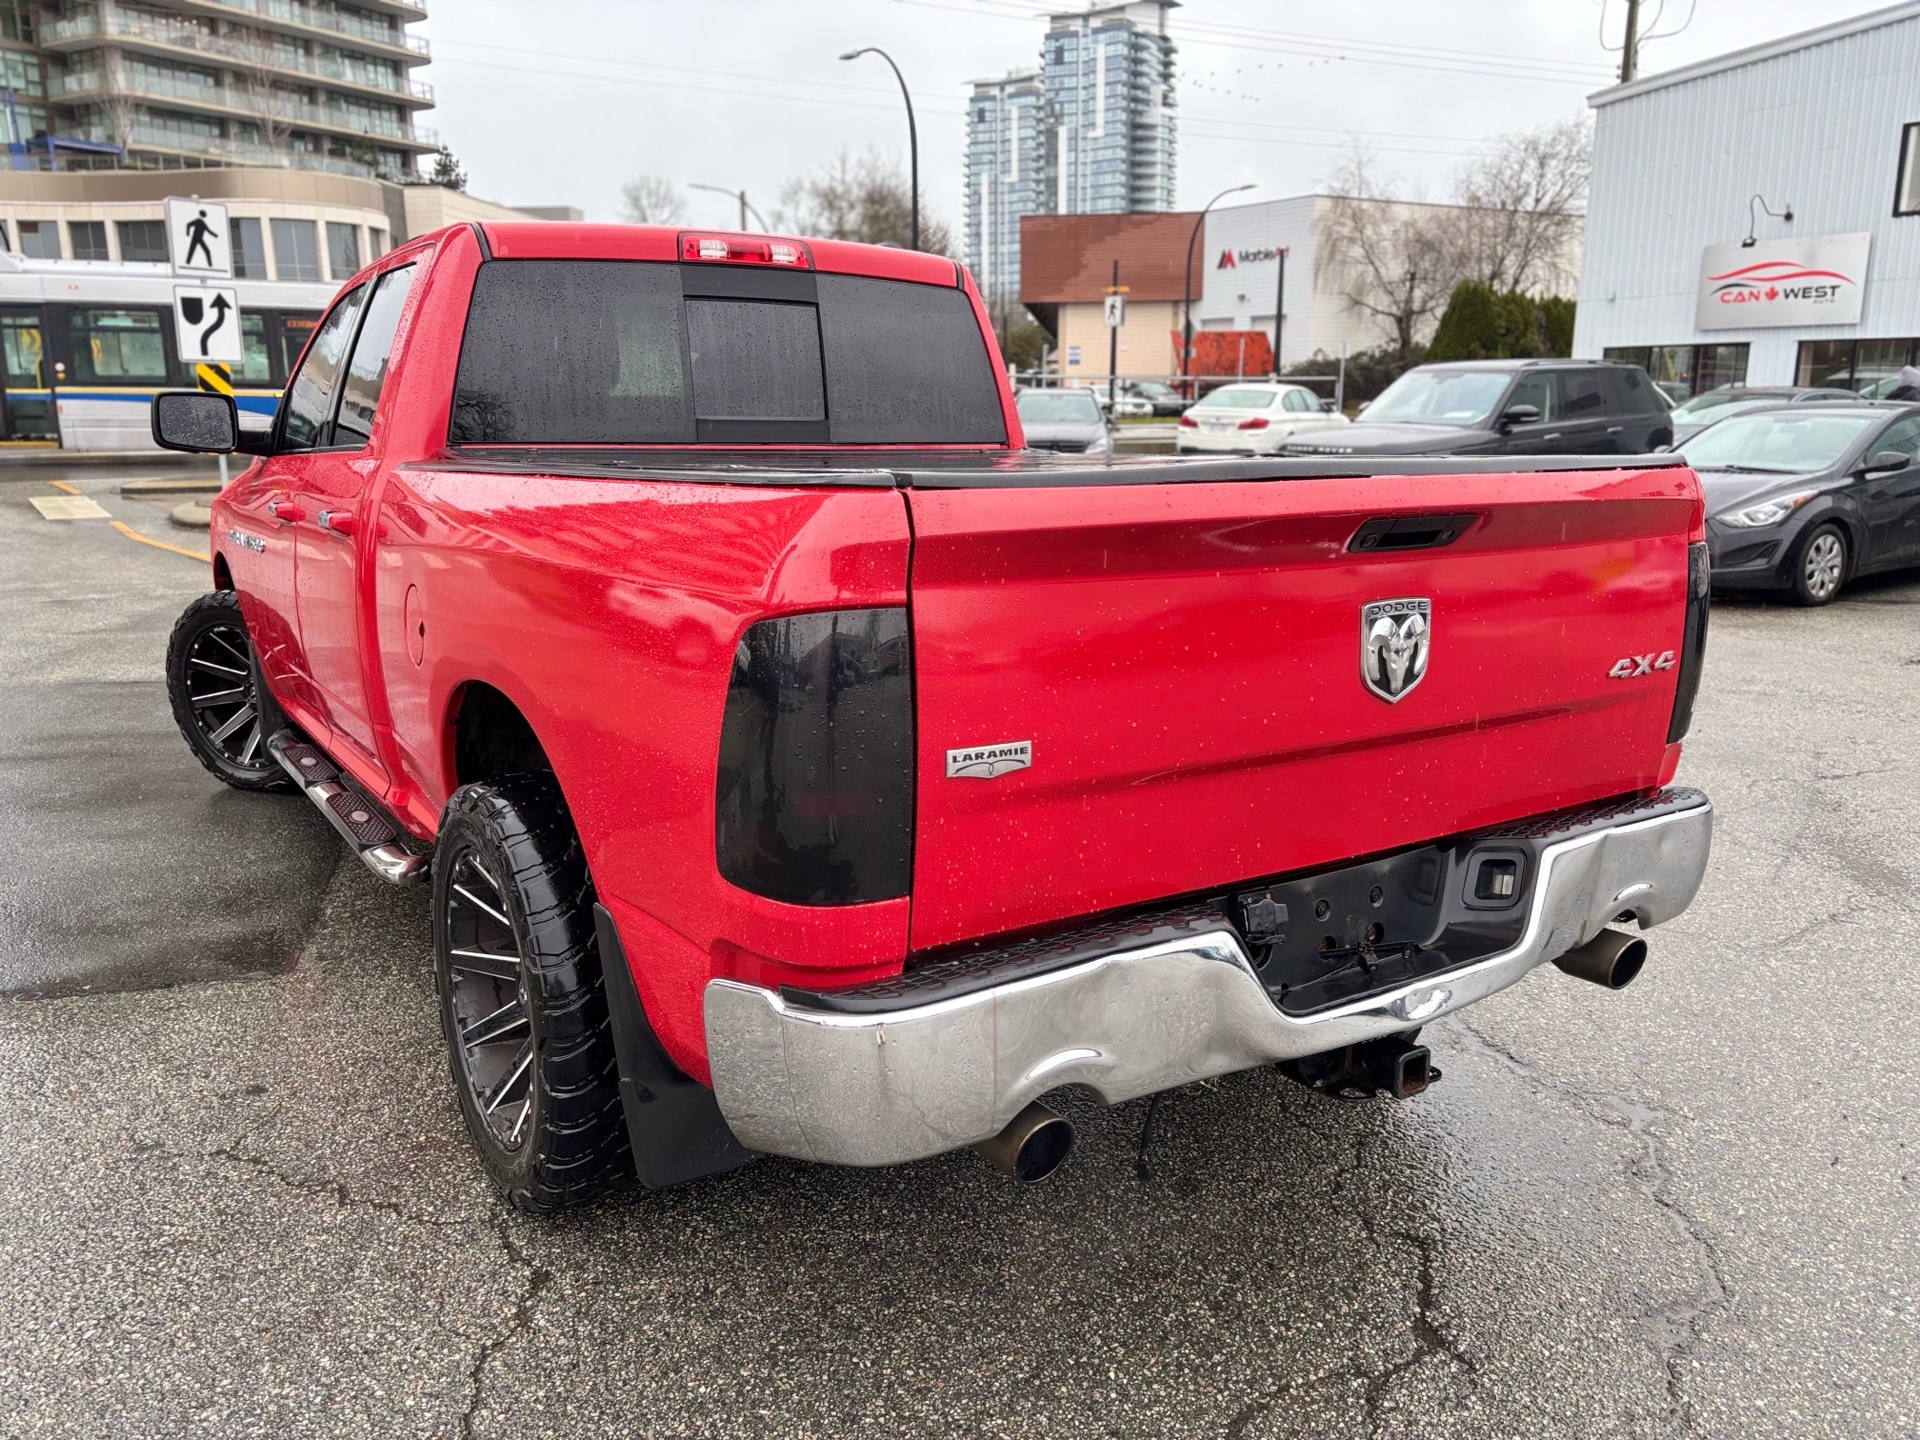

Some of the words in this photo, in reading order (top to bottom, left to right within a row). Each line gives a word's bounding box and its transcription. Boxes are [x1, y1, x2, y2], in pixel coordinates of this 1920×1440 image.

[1238, 244, 1290, 262] MarbleAt
[1719, 289, 1761, 304] CAN
[1783, 285, 1841, 300] WEST
[1370, 601, 1427, 615] DODGE
[952, 746, 1028, 763] LARAMIE
